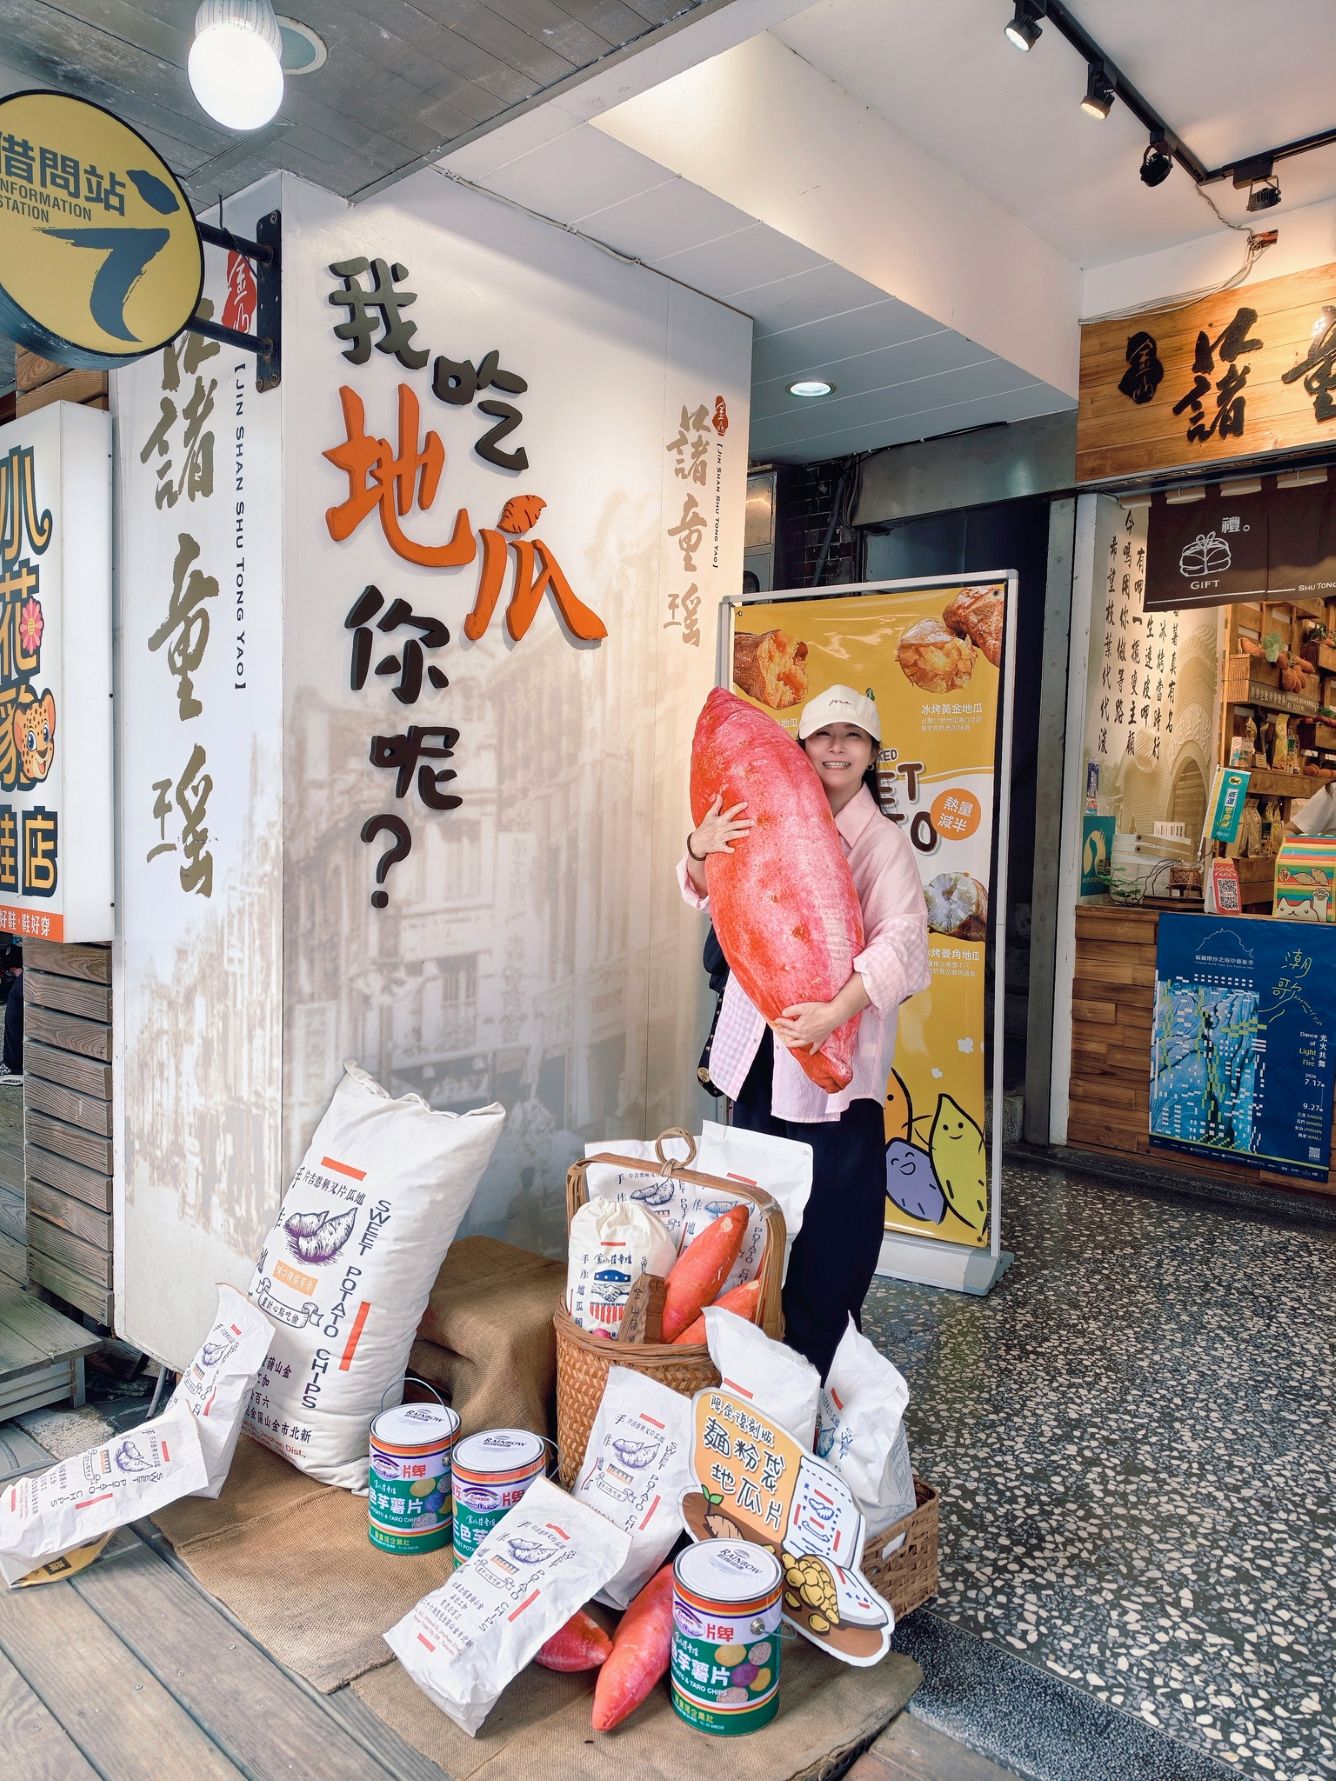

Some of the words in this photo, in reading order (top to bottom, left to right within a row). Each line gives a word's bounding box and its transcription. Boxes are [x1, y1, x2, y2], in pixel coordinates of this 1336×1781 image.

[0, 132, 126, 217] 借問站
[0, 179, 92, 222] NFORMATION
[235, 426, 245, 491] SHAN
[235, 501, 245, 549] SHU
[236, 557, 245, 621] TONG
[1190, 580, 1220, 590] GIFT
[1298, 584, 1316, 592] SHU
[775, 718, 798, 728] 地瓜
[878, 749, 898, 763] KED
[944, 796, 974, 817] 熱量
[938, 812, 968, 833] 減半
[1300, 1031, 1318, 1039] Dance
[1299, 1047, 1317, 1057] Light
[1303, 1059, 1316, 1067] Fire
[358, 1199, 392, 1256] SWEET
[745, 1227, 763, 1264] POTATO
[323, 1265, 362, 1338] POTATO
[301, 1348, 331, 1409] CHIPS
[406, 1409, 445, 1423] RAINBOW
[483, 1437, 528, 1448] RAINBOW
[88, 1479, 127, 1495] POTATO
[635, 1474, 659, 1511] POTATO
[711, 1463, 784, 1531] 地瓜片
[719, 1548, 764, 1575] RAINBOW
[510, 1569, 546, 1601] POTATO
[479, 1601, 510, 1632] CHIPS
[689, 1679, 706, 1692] TARO
